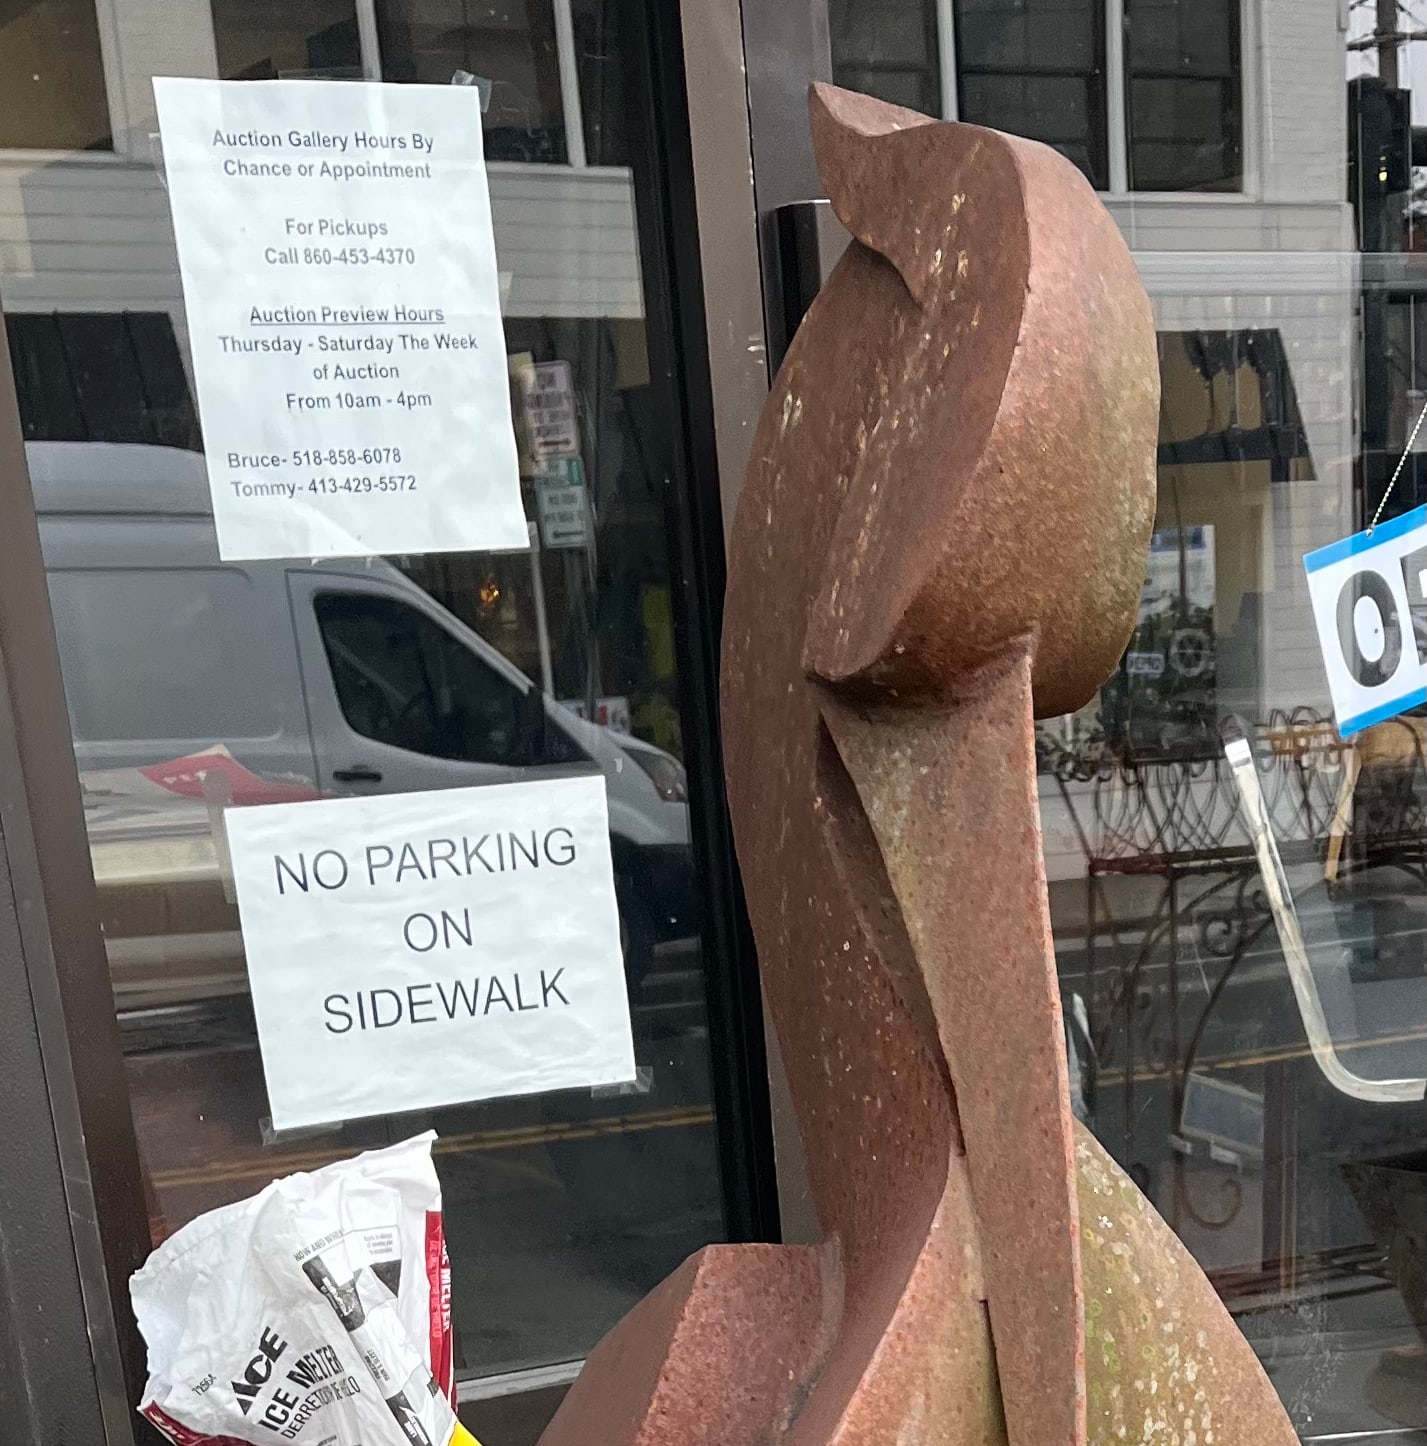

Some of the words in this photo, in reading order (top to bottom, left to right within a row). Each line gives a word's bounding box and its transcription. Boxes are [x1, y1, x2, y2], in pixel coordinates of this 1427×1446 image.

[212, 129, 283, 148] Auction
[287, 131, 349, 152] Gallery
[354, 132, 407, 149] Hours
[411, 133, 434, 154] By
[223, 159, 292, 177] Chance
[297, 164, 315, 177] or
[319, 161, 432, 181] Appointment
[285, 218, 314, 236] For
[318, 218, 389, 239] Pickups
[264, 247, 299, 265] Call
[303, 247, 416, 265] 860-453-4370
[250, 306, 317, 325] Auction
[321, 306, 389, 324] Preview
[394, 306, 446, 324] Hours
[218, 335, 303, 356] Thursday
[317, 335, 394, 355] Saturday
[398, 334, 430, 351] The
[433, 333, 479, 350] Week
[312, 363, 329, 380] of
[333, 363, 400, 380] Auction
[285, 393, 331, 411] From
[335, 392, 382, 409] 10am
[396, 391, 433, 411] 4pm
[227, 452, 288, 468] Bruce-
[292, 447, 402, 467] 518-858-6078
[230, 481, 304, 500] Tommy-
[308, 475, 417, 494] 413-429-5572
[274, 849, 349, 895] NO
[365, 827, 577, 885] PARKING
[403, 907, 474, 953] ON
[322, 966, 571, 1035] SIDEWALK
[231, 1326, 289, 1416] ACE
[258, 1388, 300, 1432] ICE
[286, 1344, 345, 1389] MELTER
